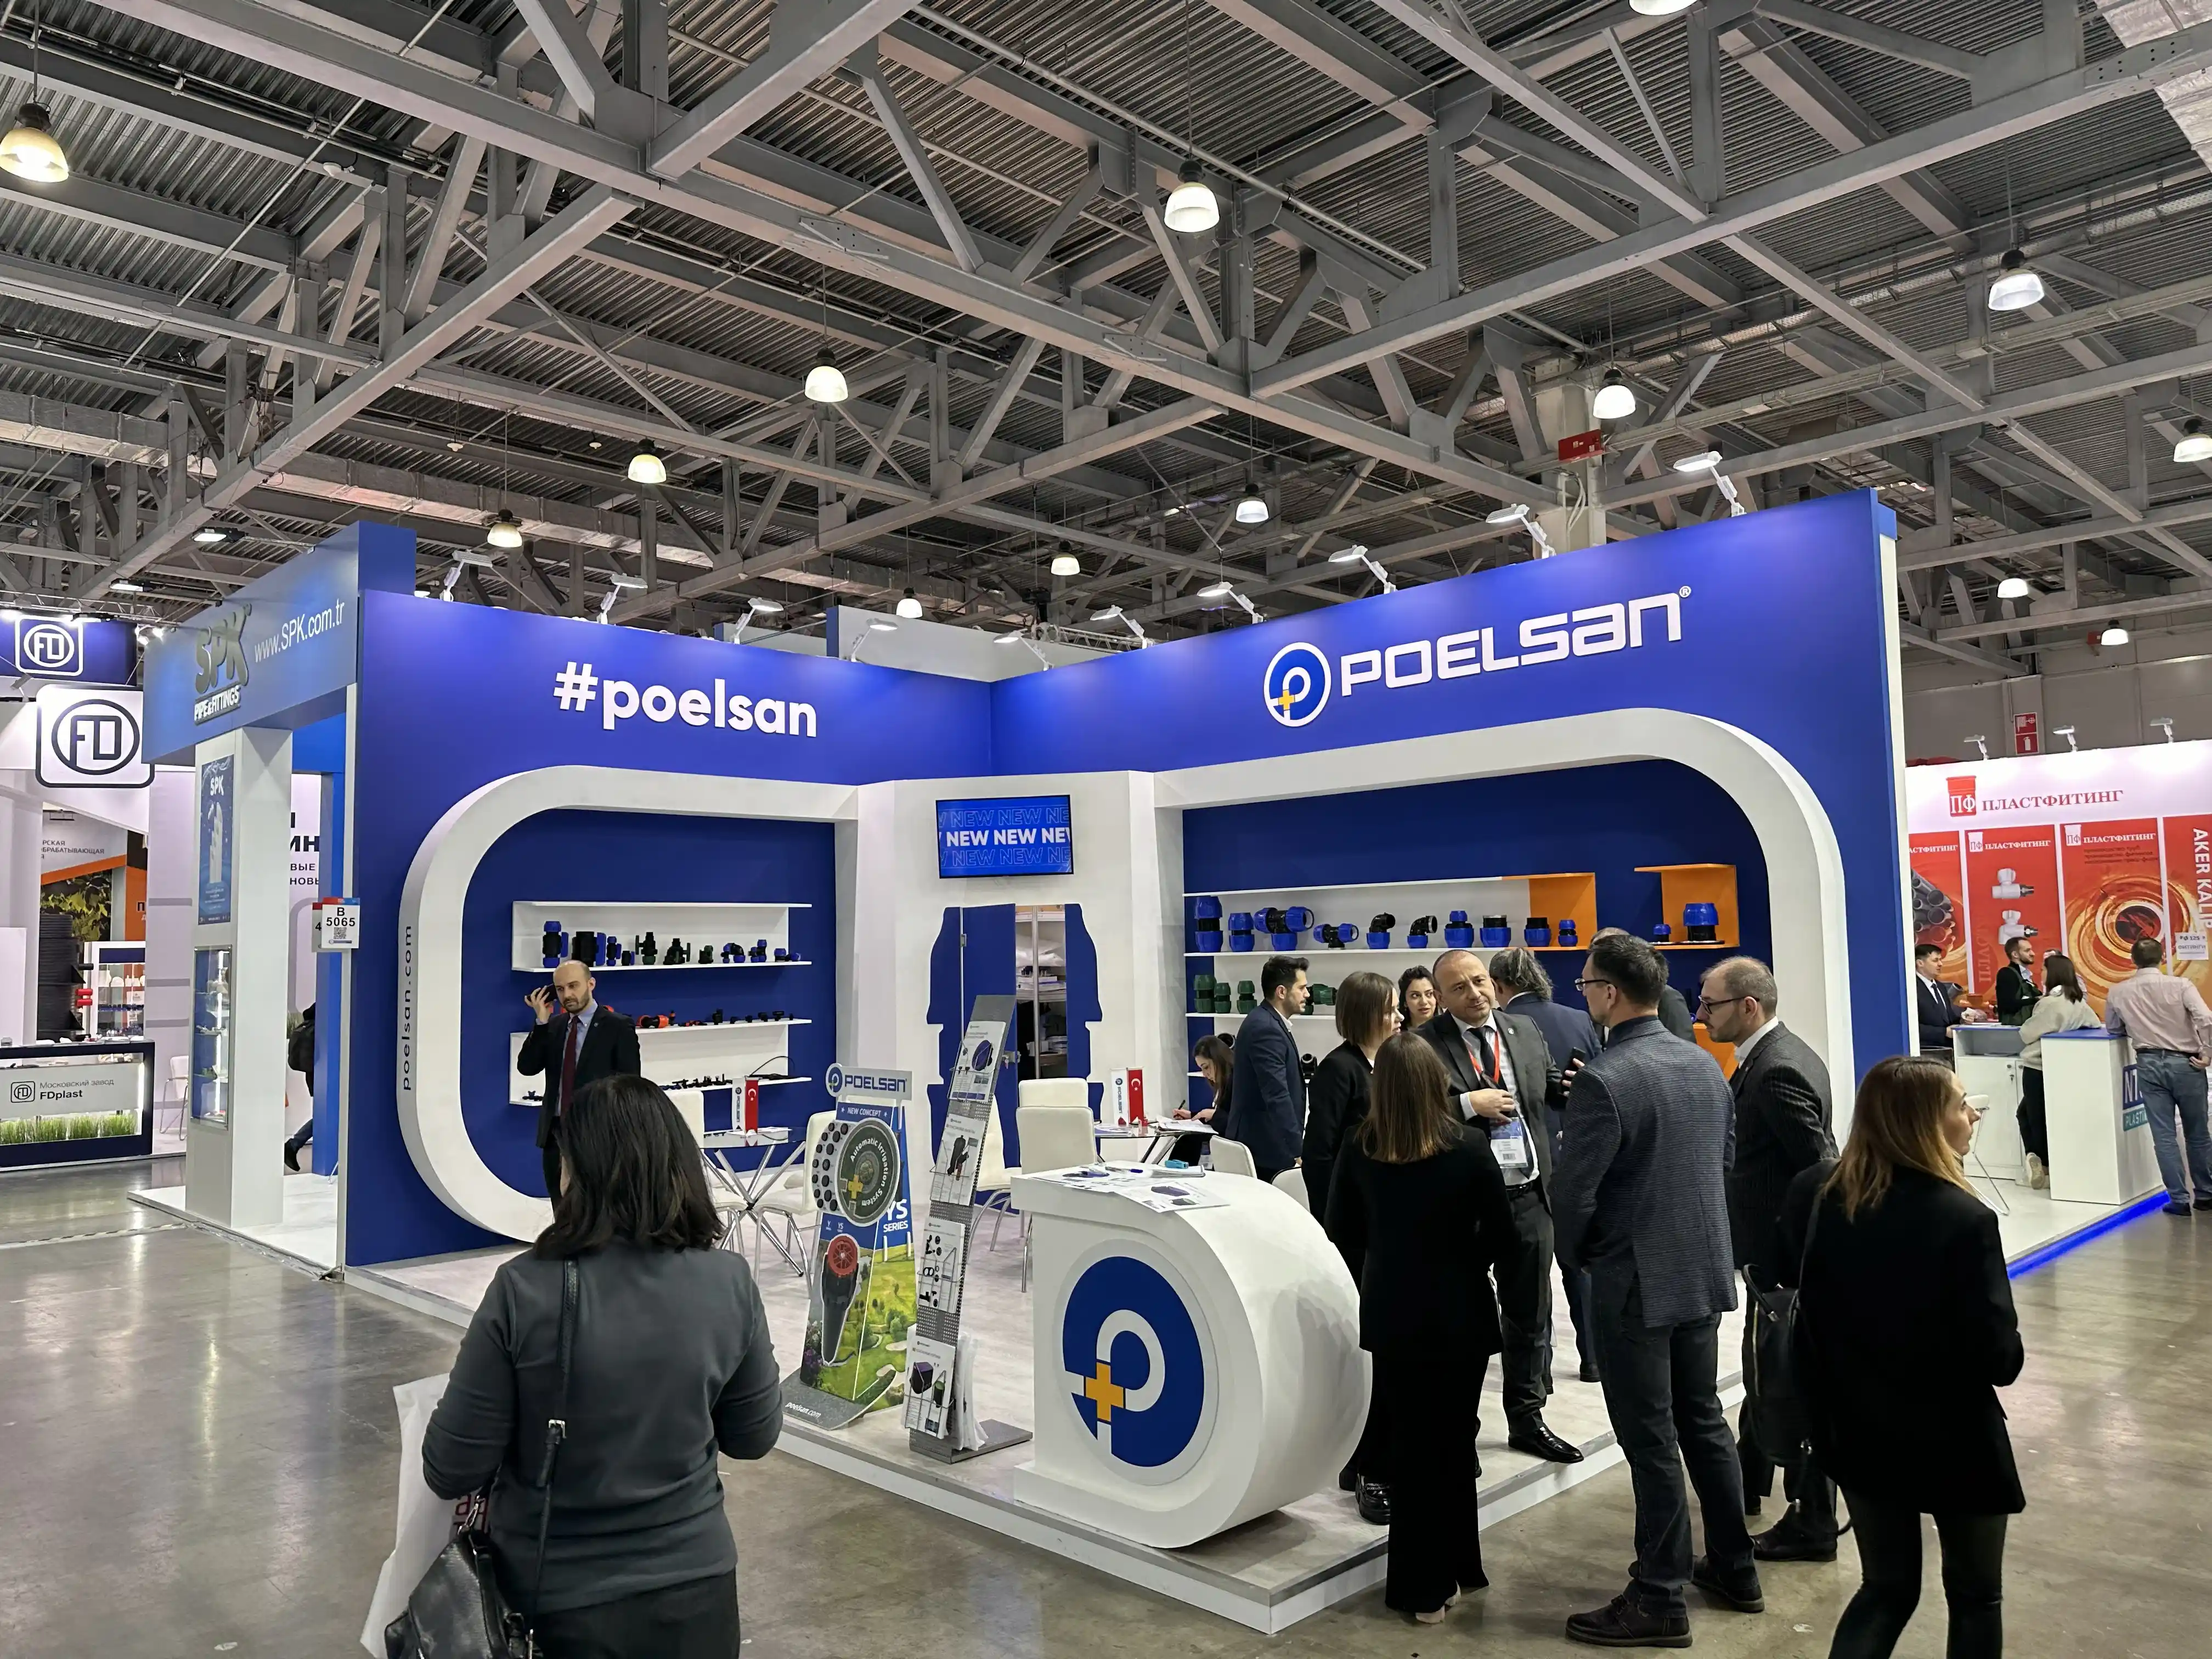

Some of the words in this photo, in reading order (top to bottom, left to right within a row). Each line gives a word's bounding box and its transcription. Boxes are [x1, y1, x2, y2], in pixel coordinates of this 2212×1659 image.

[255, 597, 345, 663] www.SPK.com.tr
[195, 606, 249, 694] SPK
[194, 685, 241, 721] PIPE&FITTINGS
[553, 661, 817, 737] #poelsan
[210, 774, 224, 796] SPK
[1950, 794, 1976, 814] ПФ
[1981, 790, 2123, 811] ПЛАСТФИТИНГ
[950, 810, 994, 827] NEW
[998, 808, 1041, 826] NEW
[947, 830, 989, 847] NEW
[994, 828, 1037, 845] NEW
[1985, 839, 2052, 850] ПЛАСТФИТИНГ
[2083, 833, 2156, 844] ПЛАСТФИТИНГ
[952, 849, 995, 867] NEW
[1000, 848, 1043, 865] NEW
[2193, 828, 2210, 874] AKER
[337, 907, 345, 916] B
[326, 917, 356, 927] 5065
[402, 926, 411, 1091] poelsan.com
[40, 1080, 89, 1089] Московский
[40, 1090, 83, 1100] FDplast
[847, 1107, 859, 1115] NEW
[859, 1108, 882, 1116] CONCEPT
[850, 1137, 878, 1163] Automatic
[861, 1188, 883, 1206] System
[887, 1199, 908, 1221] YS
[883, 1220, 909, 1233] SERIES
[785, 1402, 822, 1418] poelsan.com
